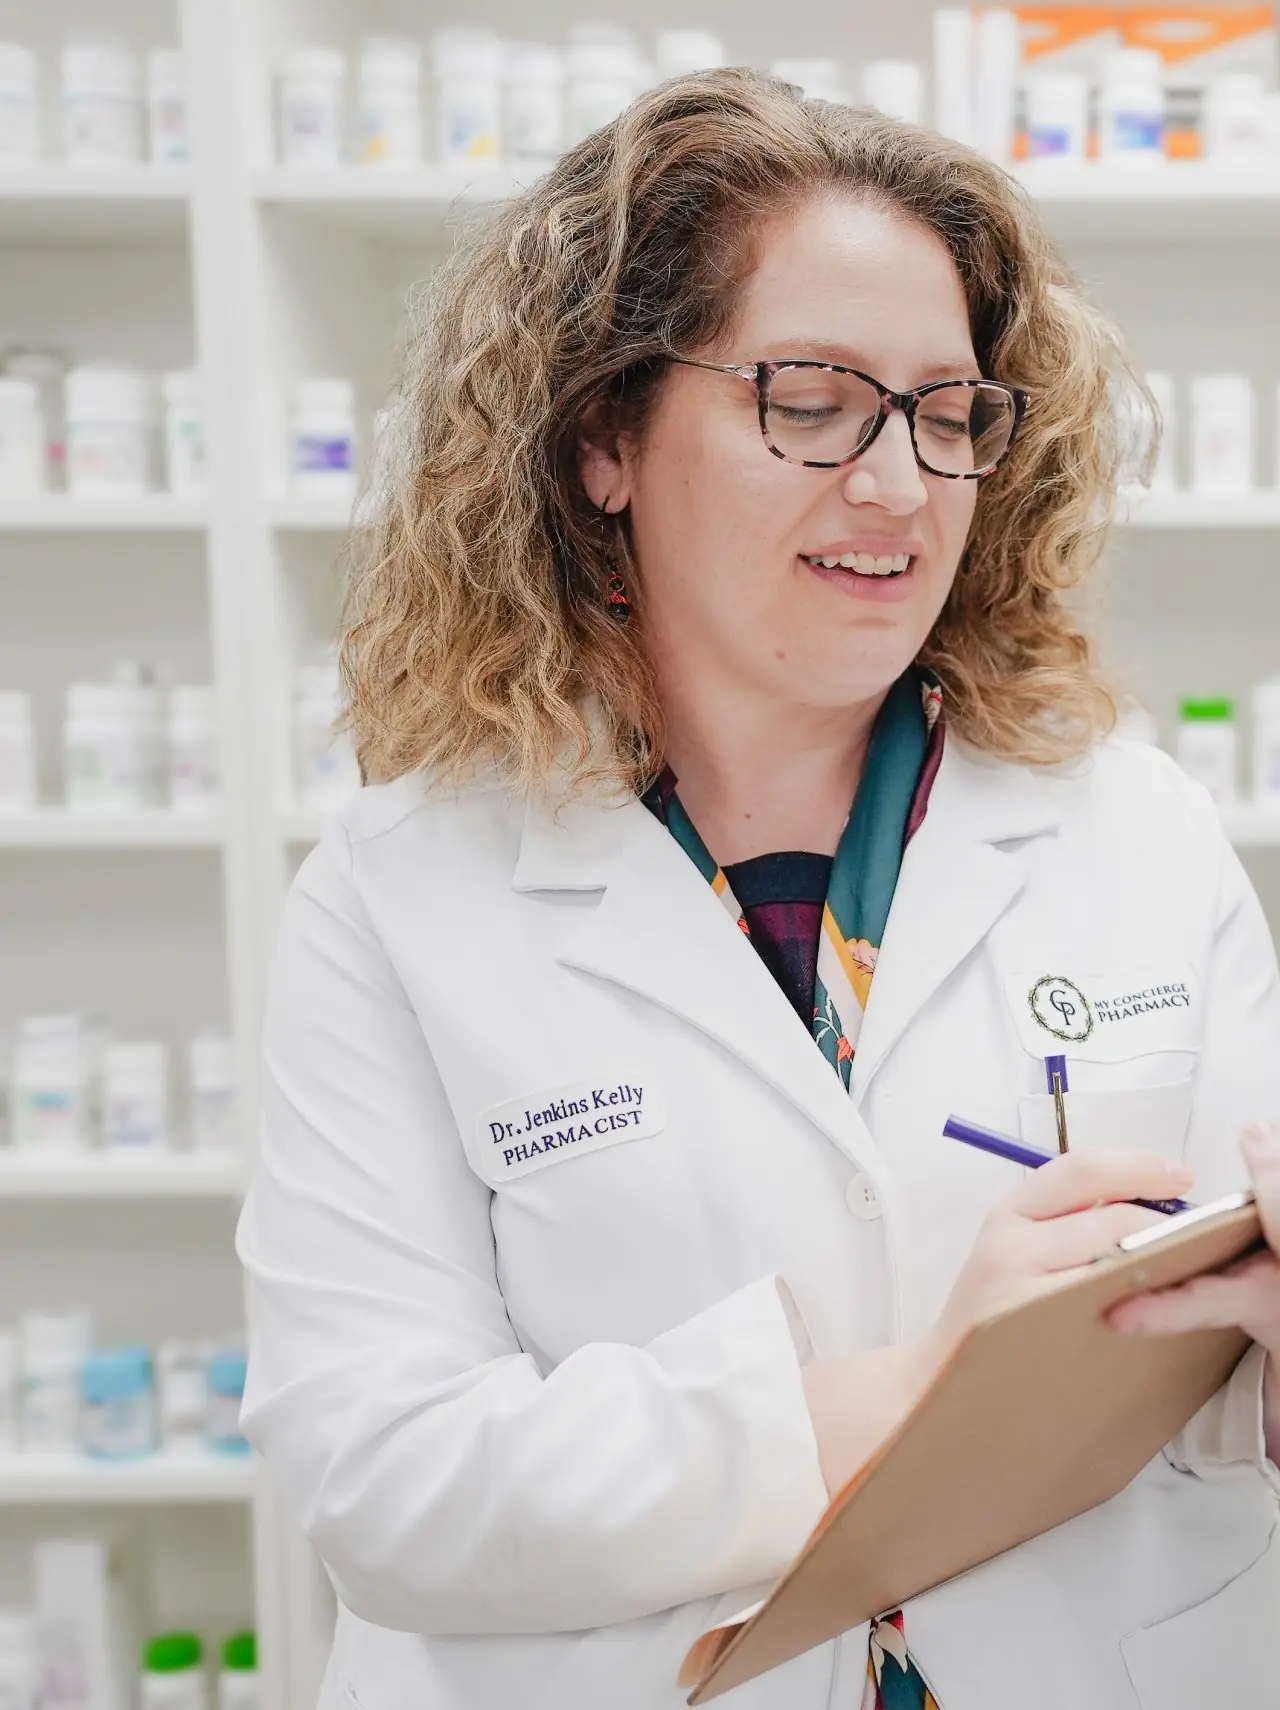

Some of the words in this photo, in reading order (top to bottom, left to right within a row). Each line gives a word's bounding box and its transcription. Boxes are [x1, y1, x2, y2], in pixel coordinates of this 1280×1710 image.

[1094, 1001, 1110, 1010] MY
[1113, 983, 1188, 1007] CONCIERGE
[1098, 994, 1191, 1023] PHARMACY
[489, 1122, 522, 1144] Dr.
[525, 1099, 590, 1131] Jenkins
[592, 1085, 643, 1109] Kelly
[503, 1110, 643, 1166] PHARMACIST
